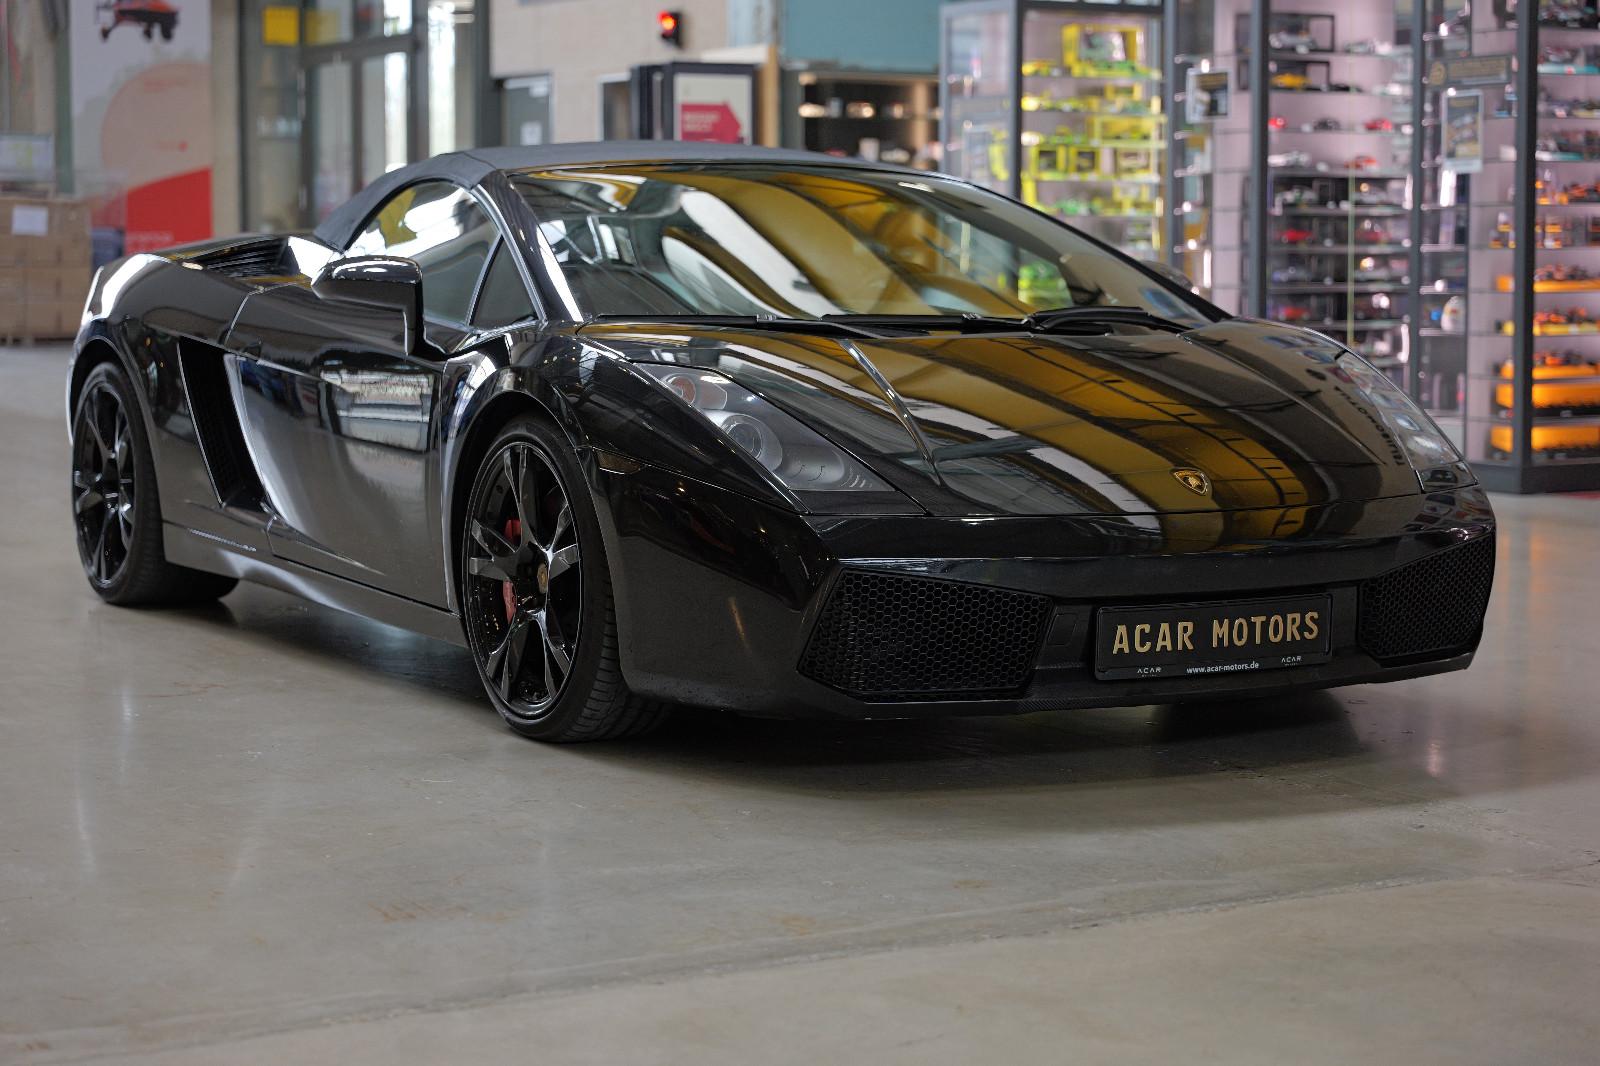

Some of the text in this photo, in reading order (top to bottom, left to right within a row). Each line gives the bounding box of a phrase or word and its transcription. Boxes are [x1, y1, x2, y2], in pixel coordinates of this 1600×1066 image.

[1112, 611, 1320, 655] ACAR MOTORS
[1281, 655, 1302, 664] ACAR
[1136, 666, 1162, 674] ACAR
[1186, 660, 1260, 675] www.acar-motors.de
